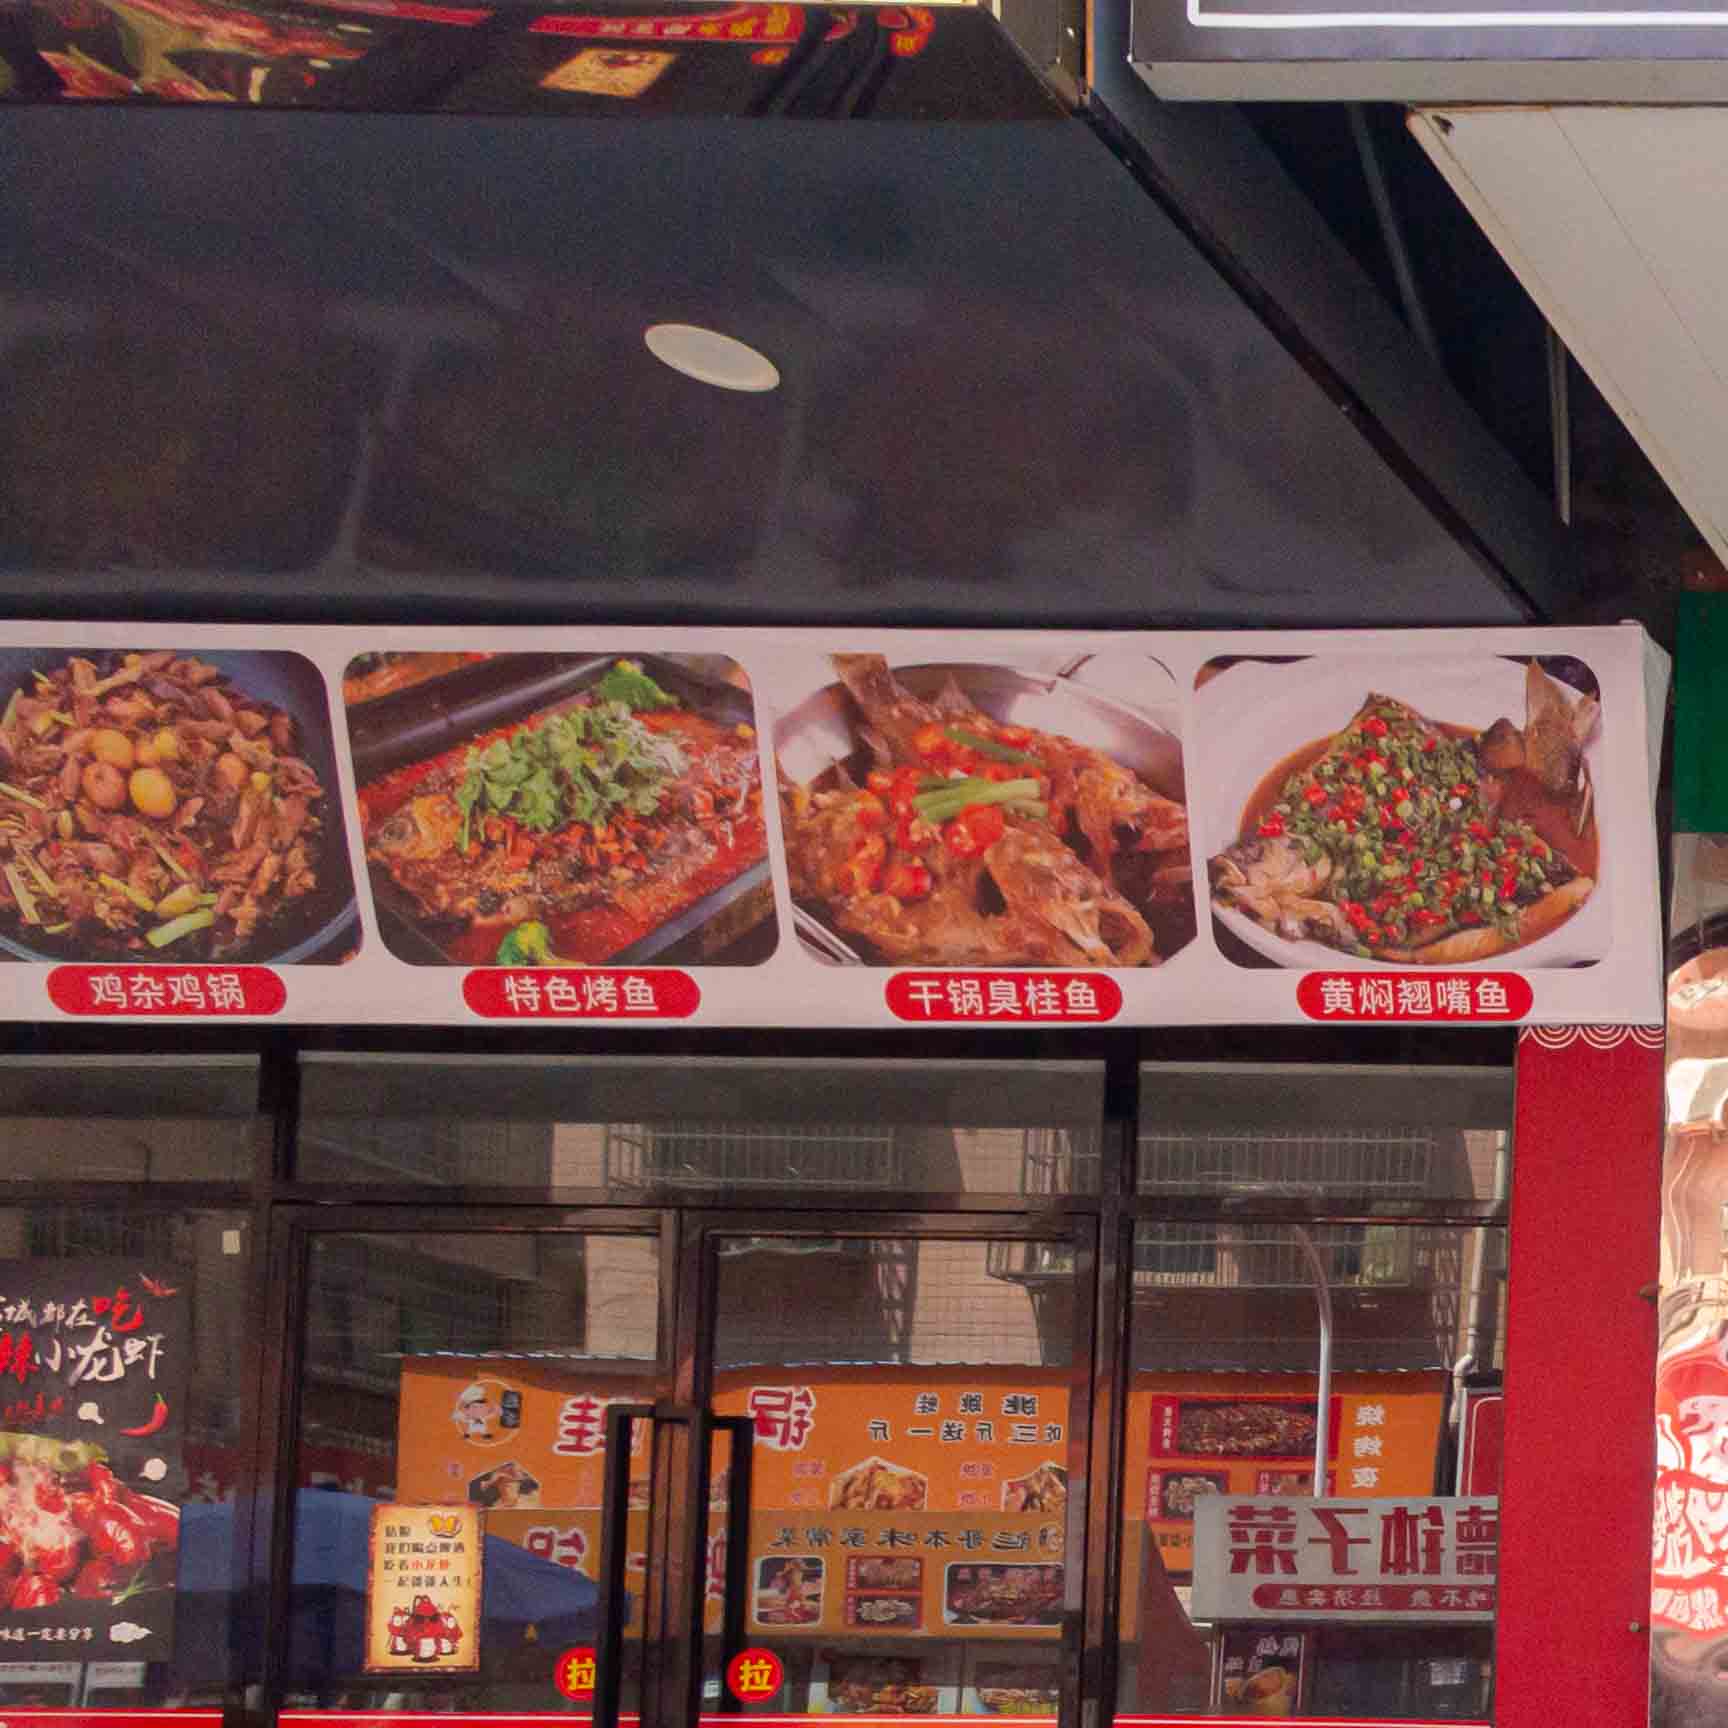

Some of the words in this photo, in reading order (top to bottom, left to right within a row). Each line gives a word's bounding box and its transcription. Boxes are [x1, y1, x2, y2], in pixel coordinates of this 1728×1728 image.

[88, 973, 247, 1010] 鸡杂鸡锅
[503, 975, 660, 1013] 特色烤鱼
[907, 978, 1101, 1016] 干锅臭桂鱼
[1320, 978, 1511, 1016] 黄焖翘嘴鱼
[738, 1657, 775, 1692] 拉
